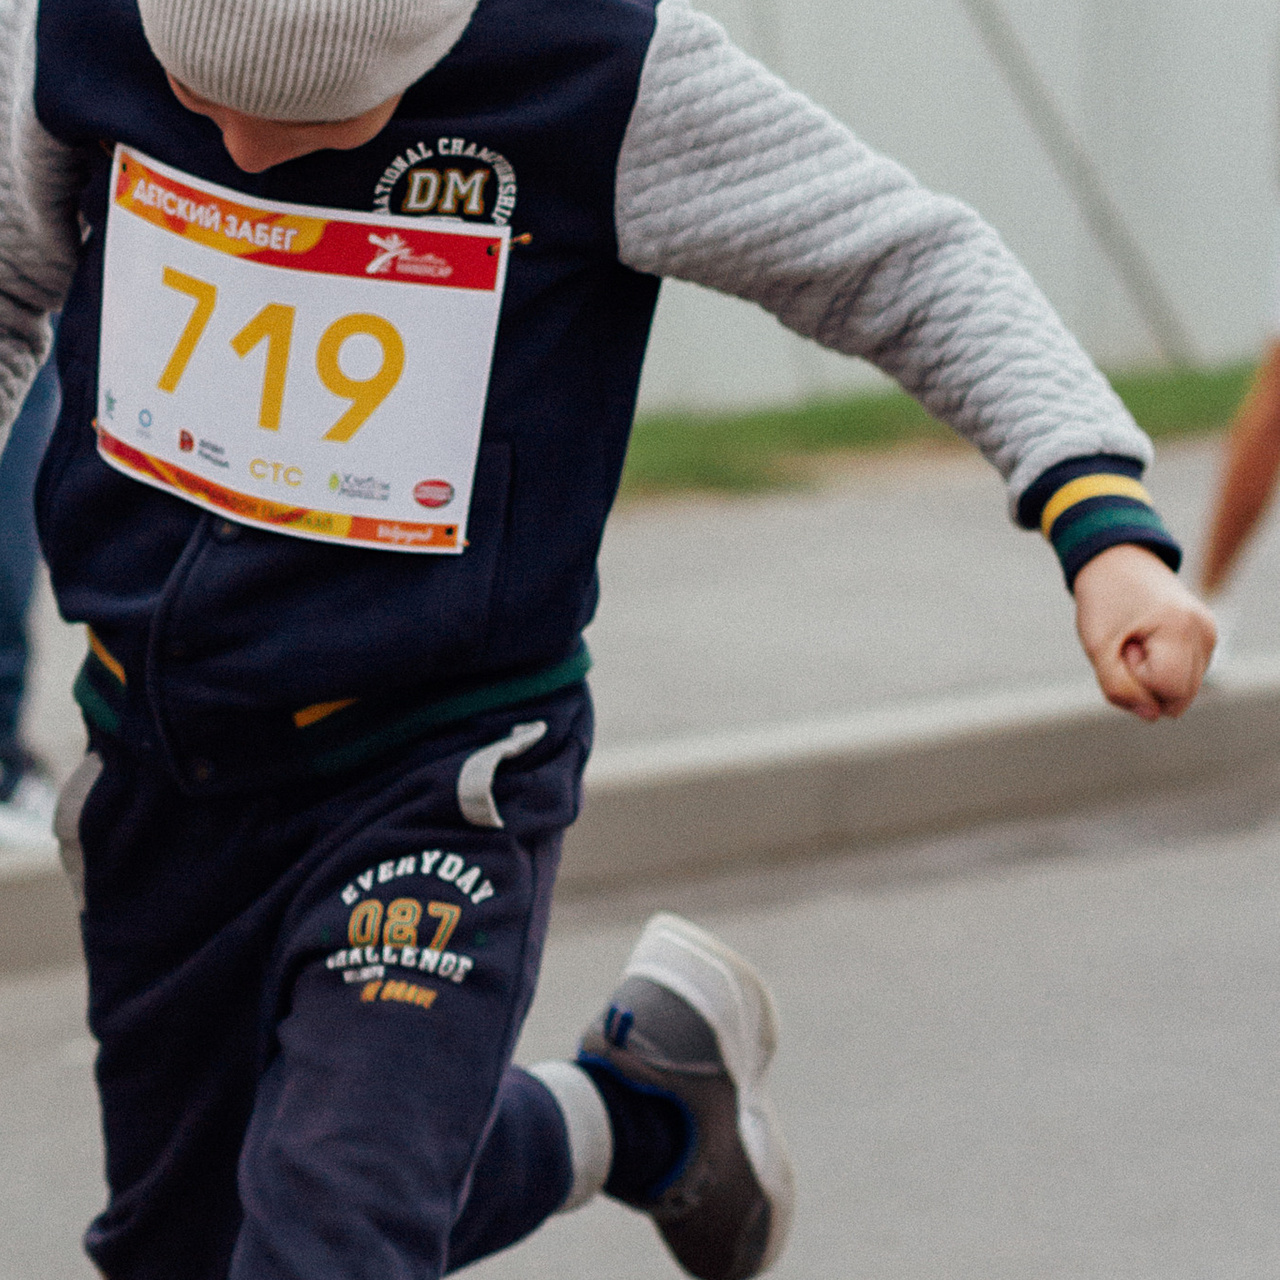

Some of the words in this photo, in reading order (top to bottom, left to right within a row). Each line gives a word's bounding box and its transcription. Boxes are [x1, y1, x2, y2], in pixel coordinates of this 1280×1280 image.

[132, 178, 221, 233] ДЕТСКИЙ
[223, 214, 298, 251] ЗАБЕГ
[402, 169, 489, 215] DM
[157, 265, 406, 443] 719
[341, 848, 495, 905] EVERYDAY
[348, 898, 461, 952] 087
